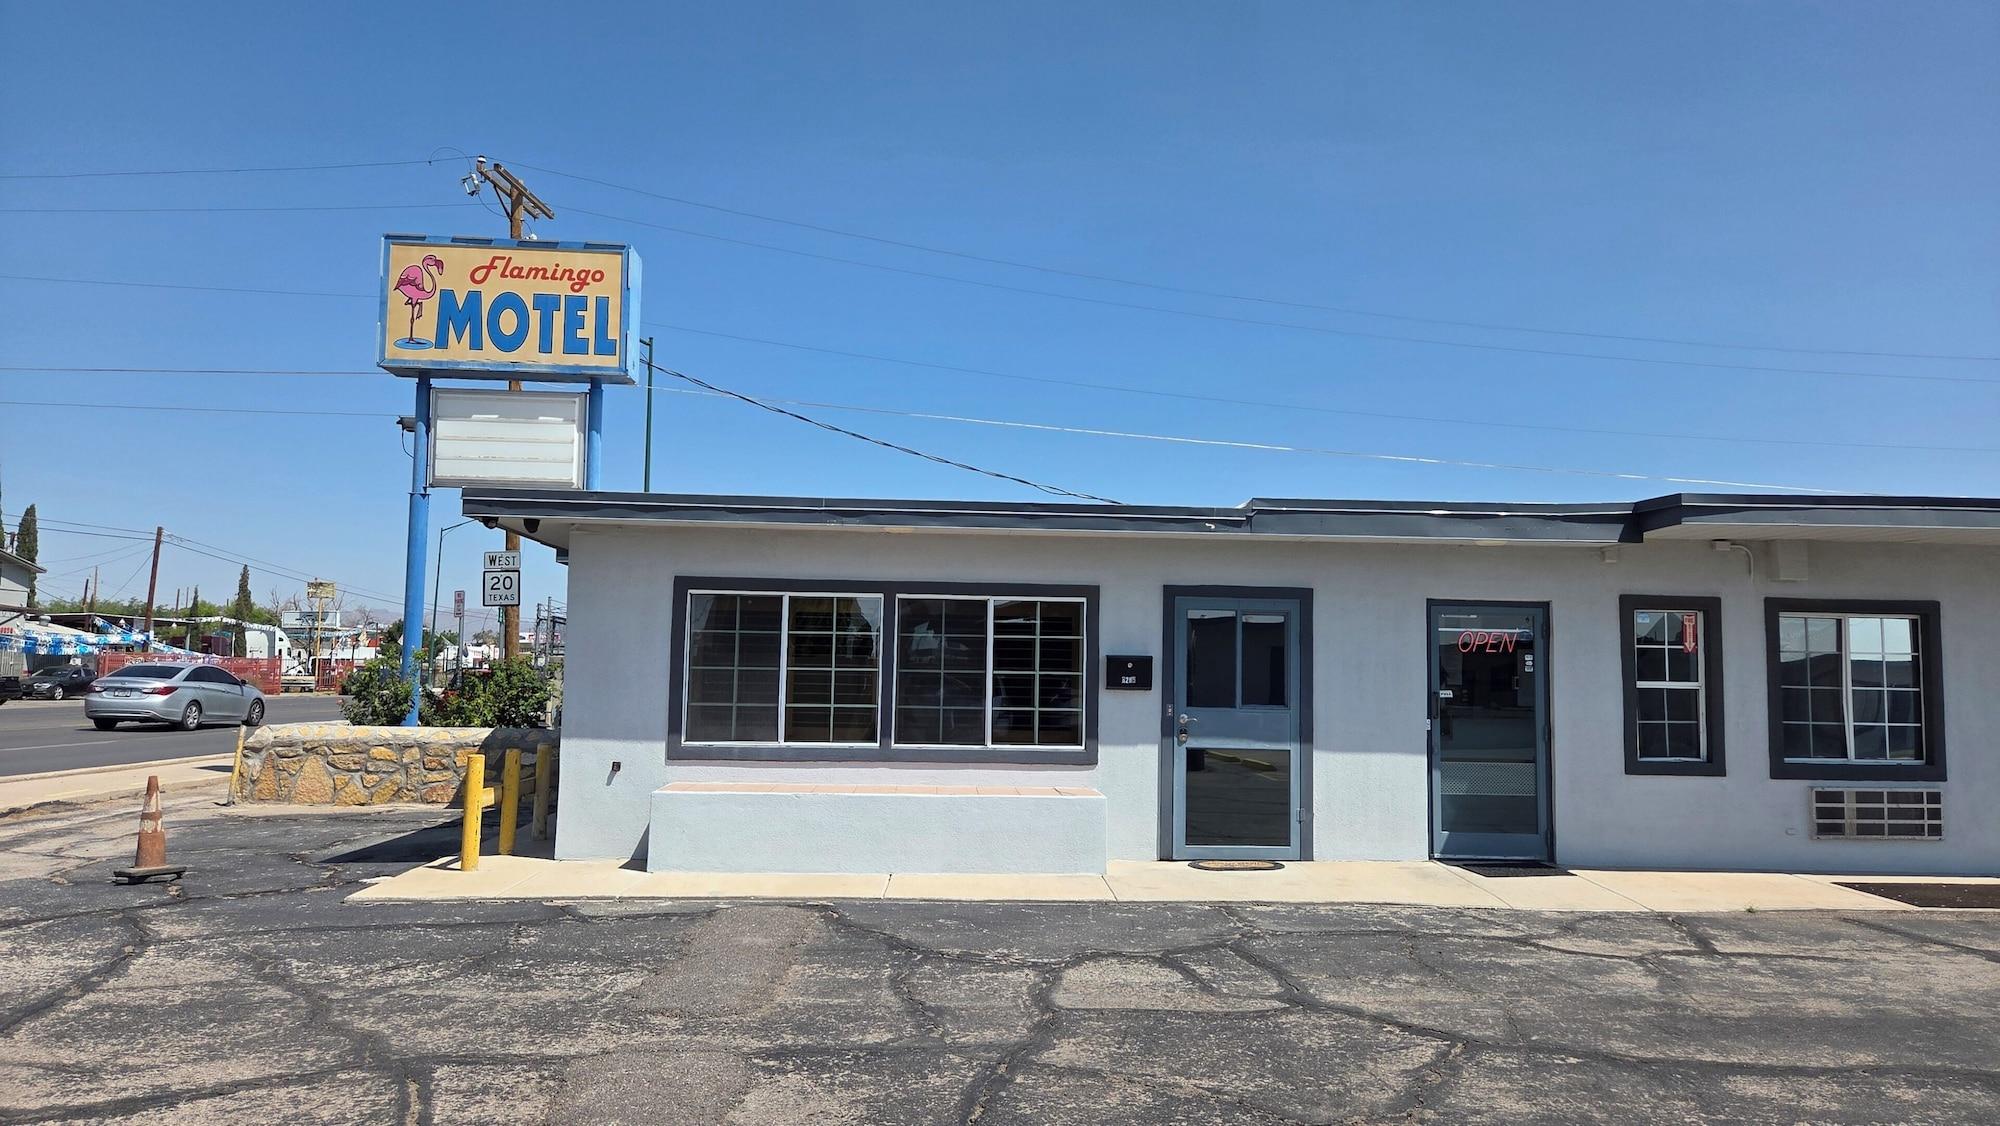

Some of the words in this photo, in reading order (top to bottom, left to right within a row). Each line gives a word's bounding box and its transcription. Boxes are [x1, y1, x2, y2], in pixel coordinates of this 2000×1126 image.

[469, 255, 605, 293] Flamingo
[434, 288, 617, 356] MOTEL
[488, 554, 517, 566] WEST
[490, 576, 513, 591] 20
[489, 593, 515, 601] TEXAS
[1458, 631, 1518, 653] OPEN
